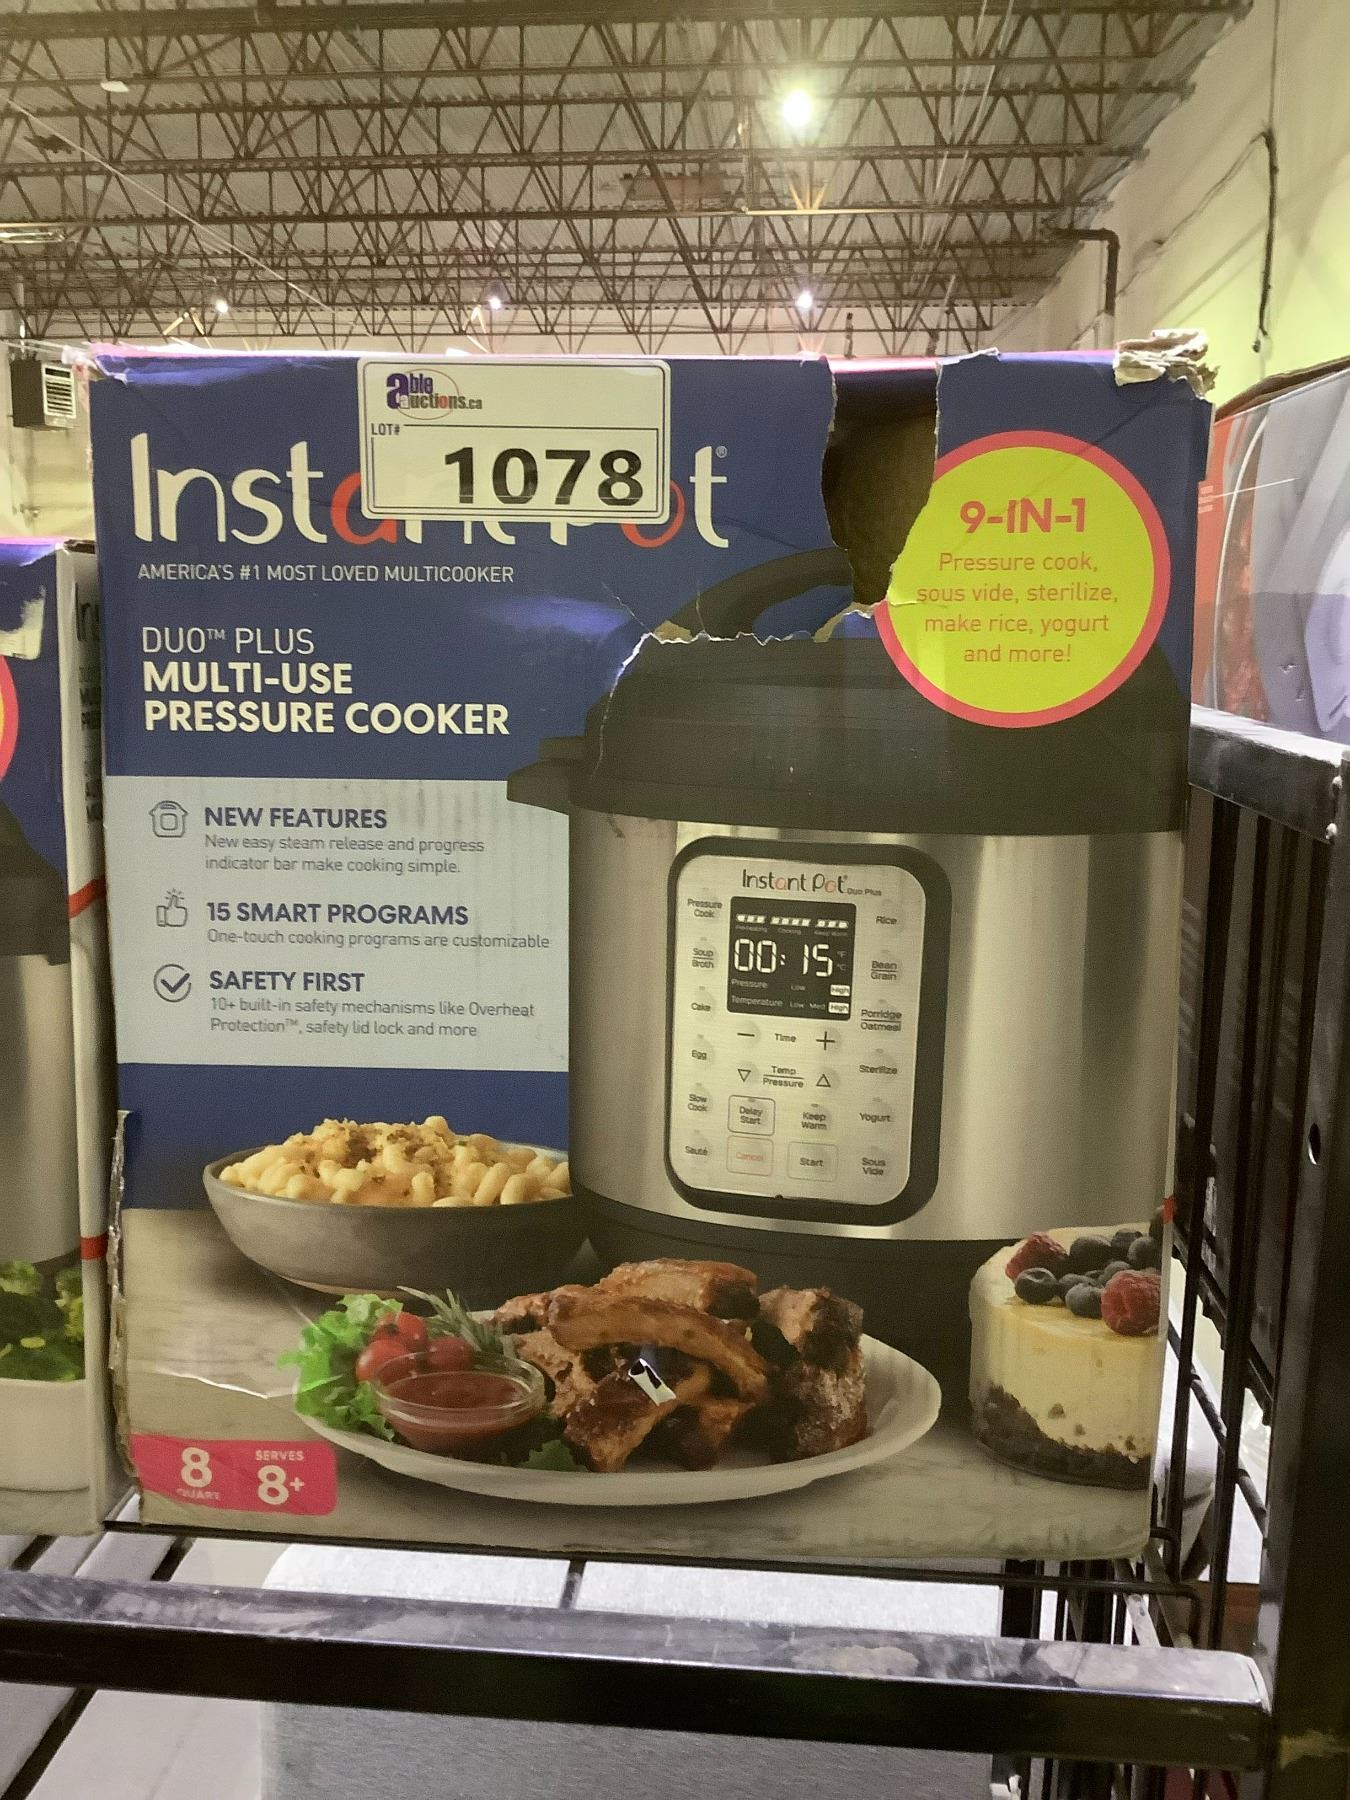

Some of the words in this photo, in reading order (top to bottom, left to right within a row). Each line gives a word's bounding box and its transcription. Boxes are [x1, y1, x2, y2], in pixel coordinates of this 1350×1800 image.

[371, 423, 400, 436] LOT#
[444, 446, 644, 506] 1078
[959, 497, 1086, 533] 9-IN-1
[137, 563, 235, 580] AMERICA'S
[239, 564, 260, 580] #1
[267, 565, 317, 581] MOST
[321, 565, 378, 582] LOVED
[384, 565, 514, 583] MULTICOOKER
[938, 552, 1035, 572] Pressure
[1042, 551, 1098, 573] cook,
[916, 588, 965, 603] sous
[972, 584, 1019, 604] vide,
[1026, 583, 1118, 604] sterilize,
[924, 614, 982, 632] make
[988, 614, 1034, 635] rice,
[1040, 614, 1110, 637] yogurt
[235, 627, 315, 655] PLUS
[963, 644, 1001, 662] and
[1008, 644, 1072, 662] more!
[143, 660, 353, 695] MULTI-USE
[144, 699, 335, 734] PRESSURE
[345, 701, 510, 735] COOKER
[204, 807, 264, 827] NEW
[269, 807, 388, 829] FEATURES
[204, 834, 239, 848] New
[242, 838, 277, 853] easy
[279, 836, 325, 850] steam
[329, 836, 384, 851] release
[387, 836, 414, 851] and
[419, 839, 486, 856] progress
[204, 855, 269, 870] indicator
[273, 856, 299, 871] bar
[301, 857, 343, 872] make
[347, 858, 404, 877] cooking
[407, 858, 461, 877] simple.
[742, 868, 807, 892] Instant
[206, 902, 231, 921] 15
[236, 902, 322, 923] SMART
[327, 903, 469, 925] PROGRAMS
[207, 928, 285, 944] One-touch
[287, 931, 345, 948] cooking
[348, 932, 421, 949] programs
[423, 935, 449, 947] are
[452, 934, 550, 949] customizable
[209, 970, 297, 991] SAFETY
[302, 971, 366, 993] FIRST
[211, 998, 236, 1011] 10+
[239, 997, 291, 1012] built-in
[295, 998, 339, 1017] safety
[341, 999, 436, 1014] mechanisms
[439, 1000, 465, 1016] like
[468, 1001, 535, 1017] Overheat
[305, 1019, 350, 1037] safety
[352, 1020, 370, 1034] lid
[373, 1020, 404, 1035] lock
[407, 1022, 435, 1036] and
[438, 1024, 478, 1037] more
[771, 1065, 797, 1076] Temp
[762, 1077, 804, 1088] Pressure
[802, 1111, 827, 1122] Keep
[859, 1112, 891, 1123] Yogurt
[799, 1157, 824, 1167] Start
[255, 1449, 305, 1461] SERVES
[180, 1446, 213, 1488] 8
